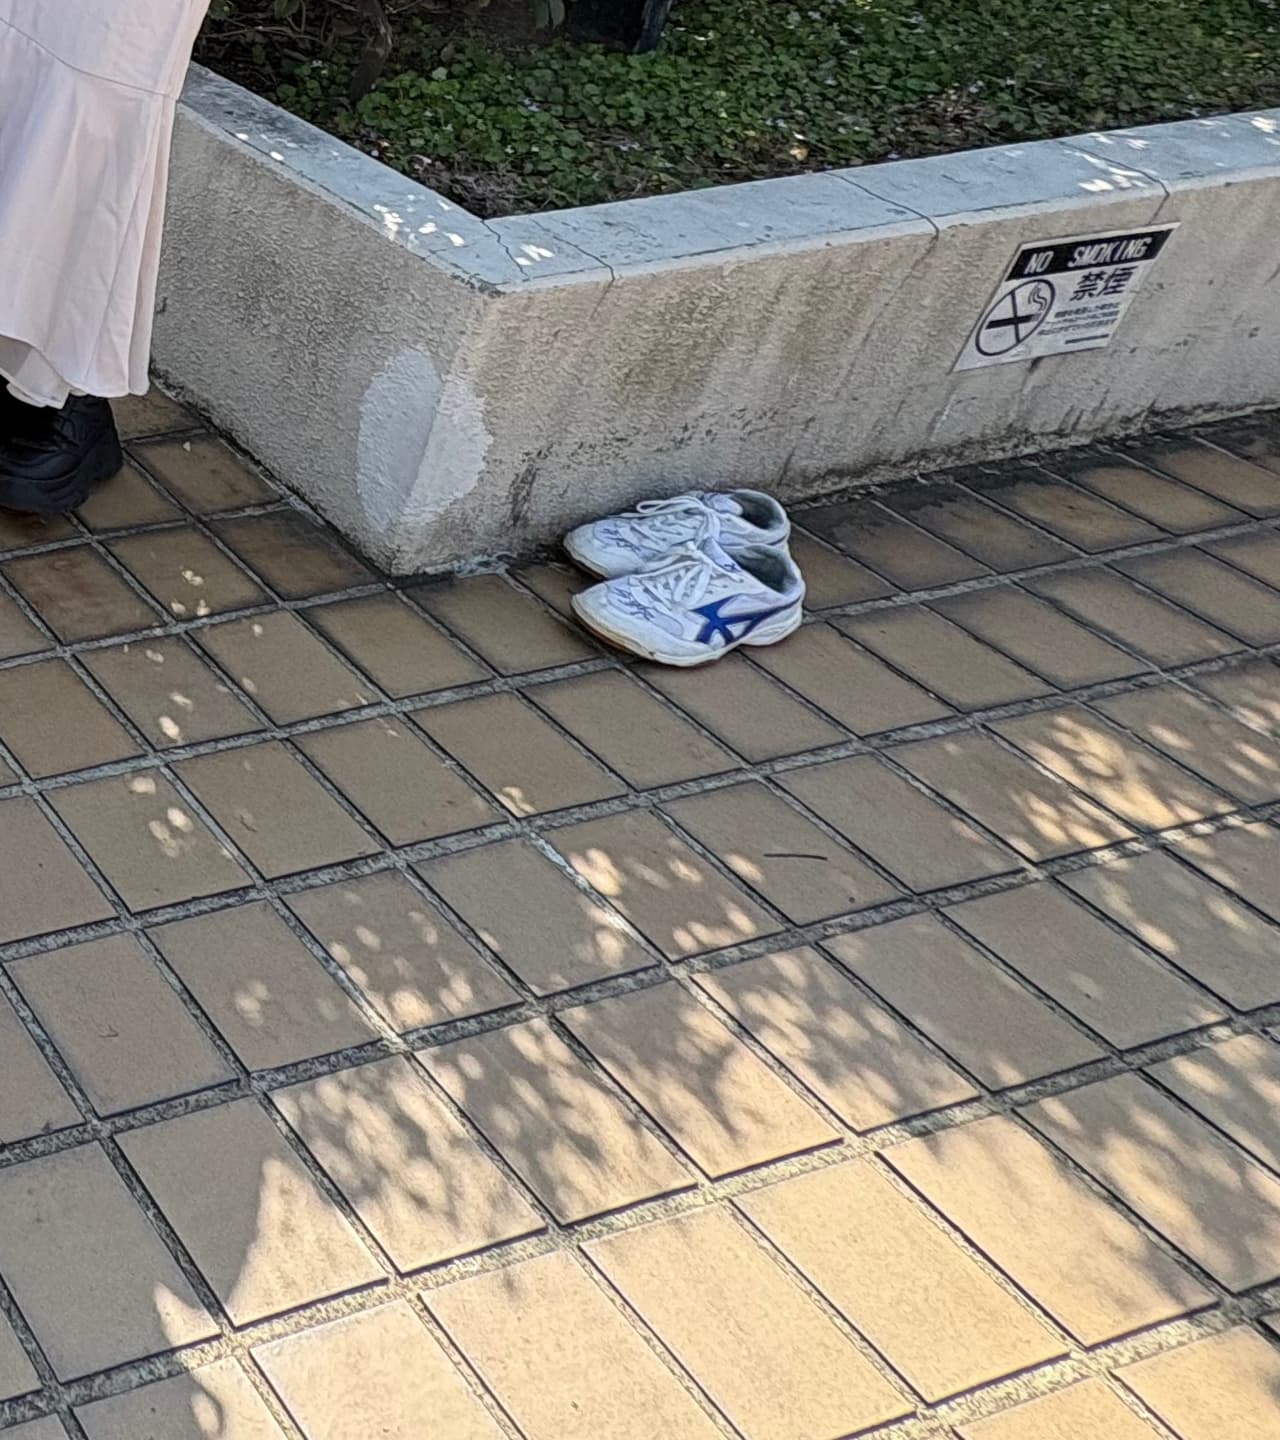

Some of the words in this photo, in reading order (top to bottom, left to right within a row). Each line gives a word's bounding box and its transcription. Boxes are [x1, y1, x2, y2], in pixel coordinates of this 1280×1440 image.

[1023, 250, 1055, 275] NO
[1067, 237, 1153, 268] SMOKING
[1069, 265, 1139, 302] 禁煙
